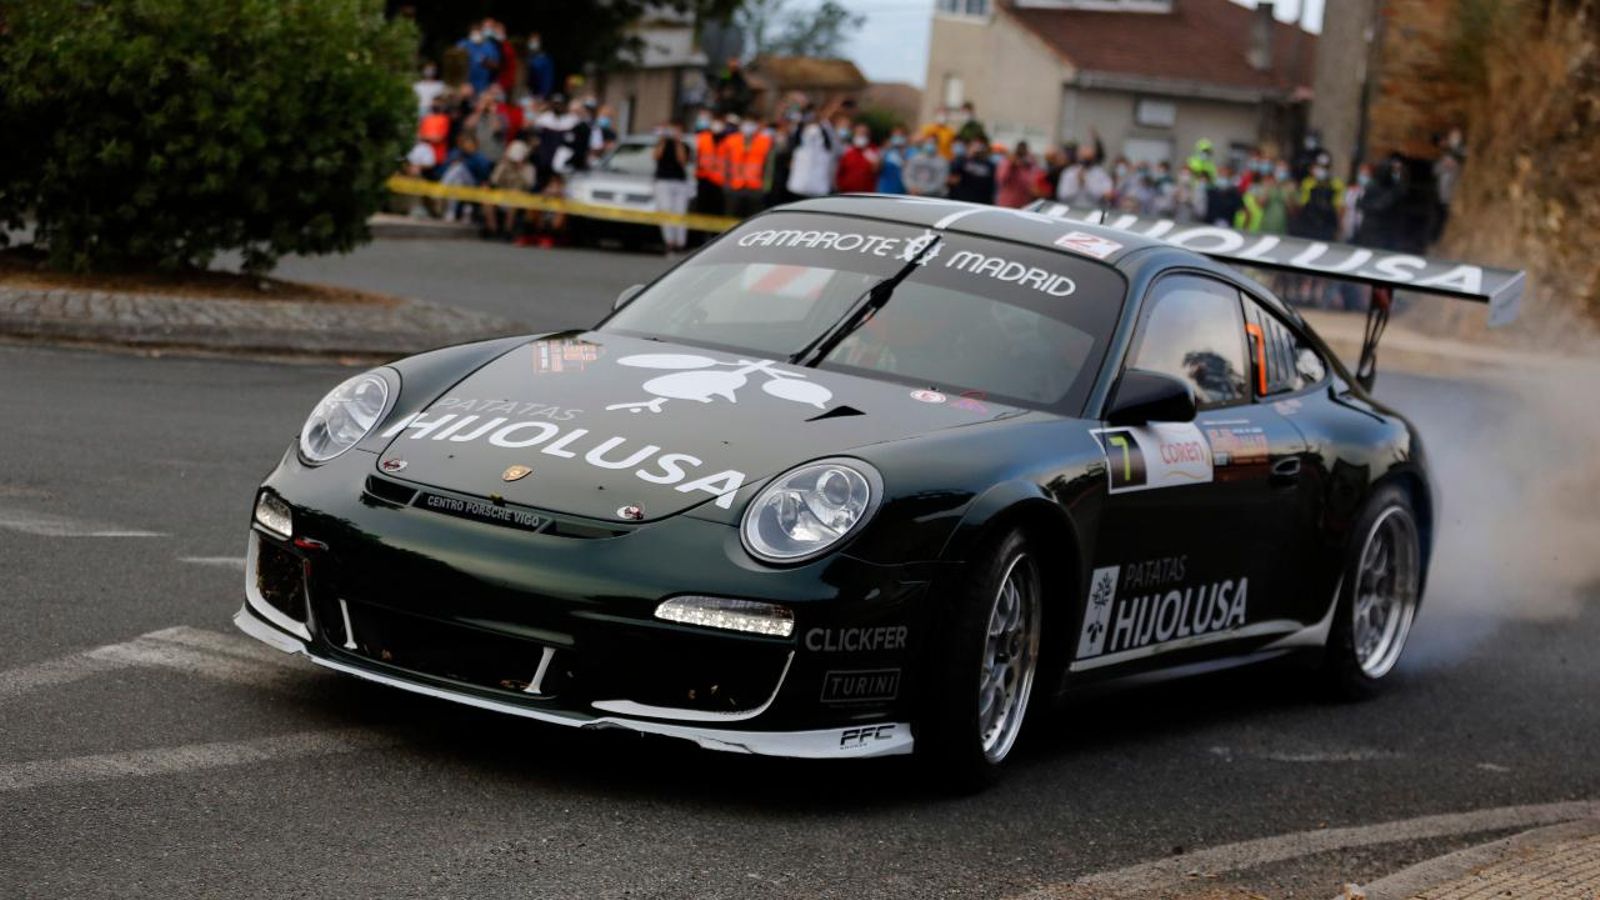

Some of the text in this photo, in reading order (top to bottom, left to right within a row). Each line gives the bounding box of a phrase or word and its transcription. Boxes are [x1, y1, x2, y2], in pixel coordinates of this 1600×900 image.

[738, 230, 1076, 298] CAMAROTE MADRID
[435, 397, 585, 421] PATATAS
[381, 411, 746, 510] HIJOLUSA
[1109, 435, 1131, 481] 7
[427, 495, 540, 527] CENTRO PORSCHE VIGO
[1123, 554, 1188, 591] PATATAS
[1110, 576, 1248, 652] HIJOLUSA
[805, 625, 908, 652] CLICKFER
[831, 676, 895, 697] TURINI
[840, 724, 896, 746] PFC
